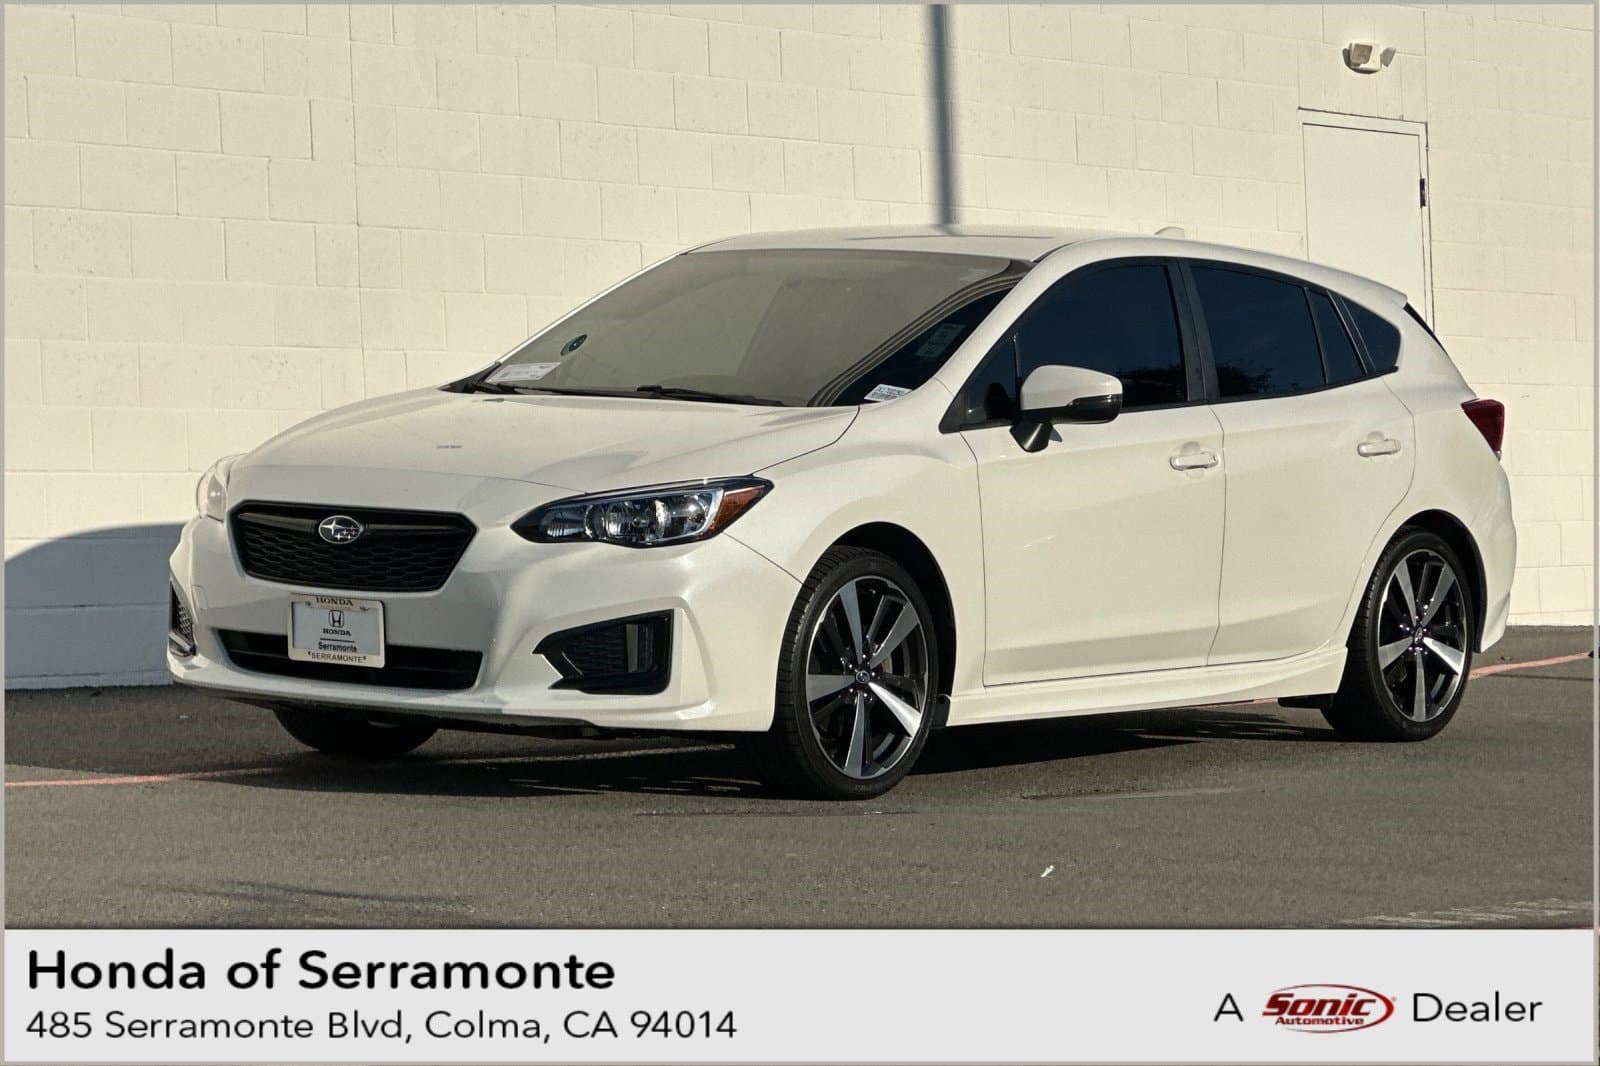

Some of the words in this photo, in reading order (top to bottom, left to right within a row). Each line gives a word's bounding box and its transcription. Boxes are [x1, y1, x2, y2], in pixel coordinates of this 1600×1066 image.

[316, 597, 354, 606] HONDA
[323, 628, 352, 636] HONDA
[318, 641, 357, 652] Serramonte
[311, 652, 363, 663] SERRAMONTE
